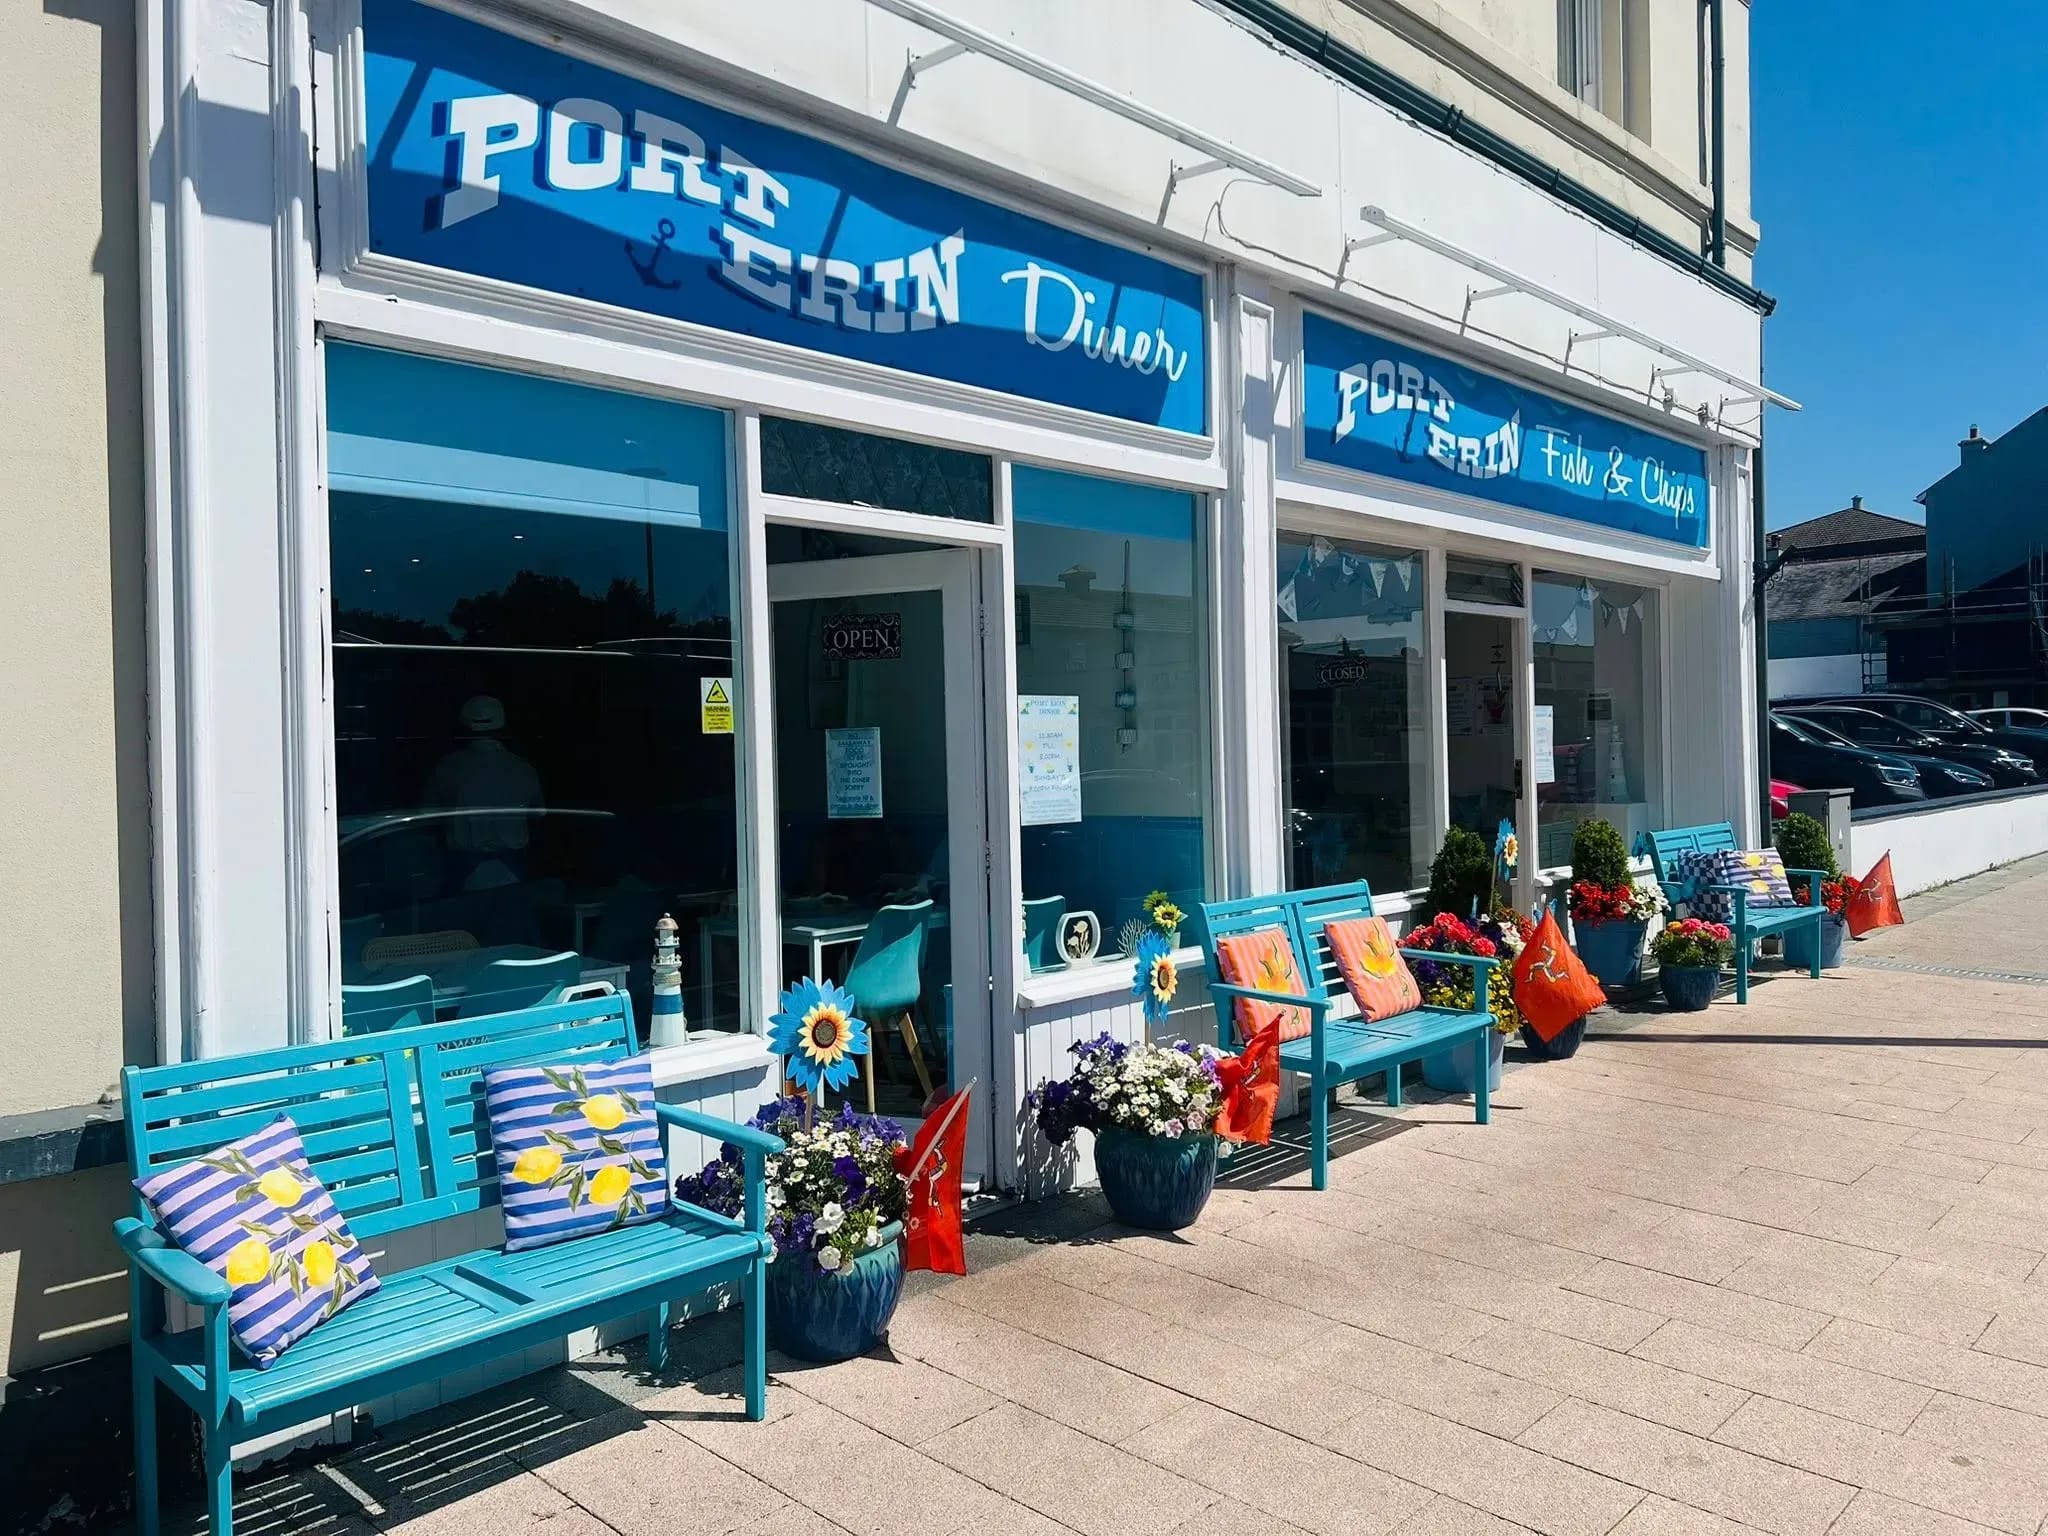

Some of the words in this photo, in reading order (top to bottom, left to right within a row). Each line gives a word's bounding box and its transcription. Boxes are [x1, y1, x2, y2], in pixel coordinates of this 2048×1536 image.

[440, 92, 790, 231] PORT
[719, 223, 966, 335] ERIN
[1002, 263, 1187, 383] Diner
[1335, 358, 1455, 445] PORT
[1426, 407, 1521, 480] ERIN
[1535, 423, 1594, 487] Fish
[1602, 445, 1633, 498] &
[1640, 456, 1696, 531] Chips
[833, 628, 889, 649] OPEN
[1319, 664, 1366, 682] CLOSED
